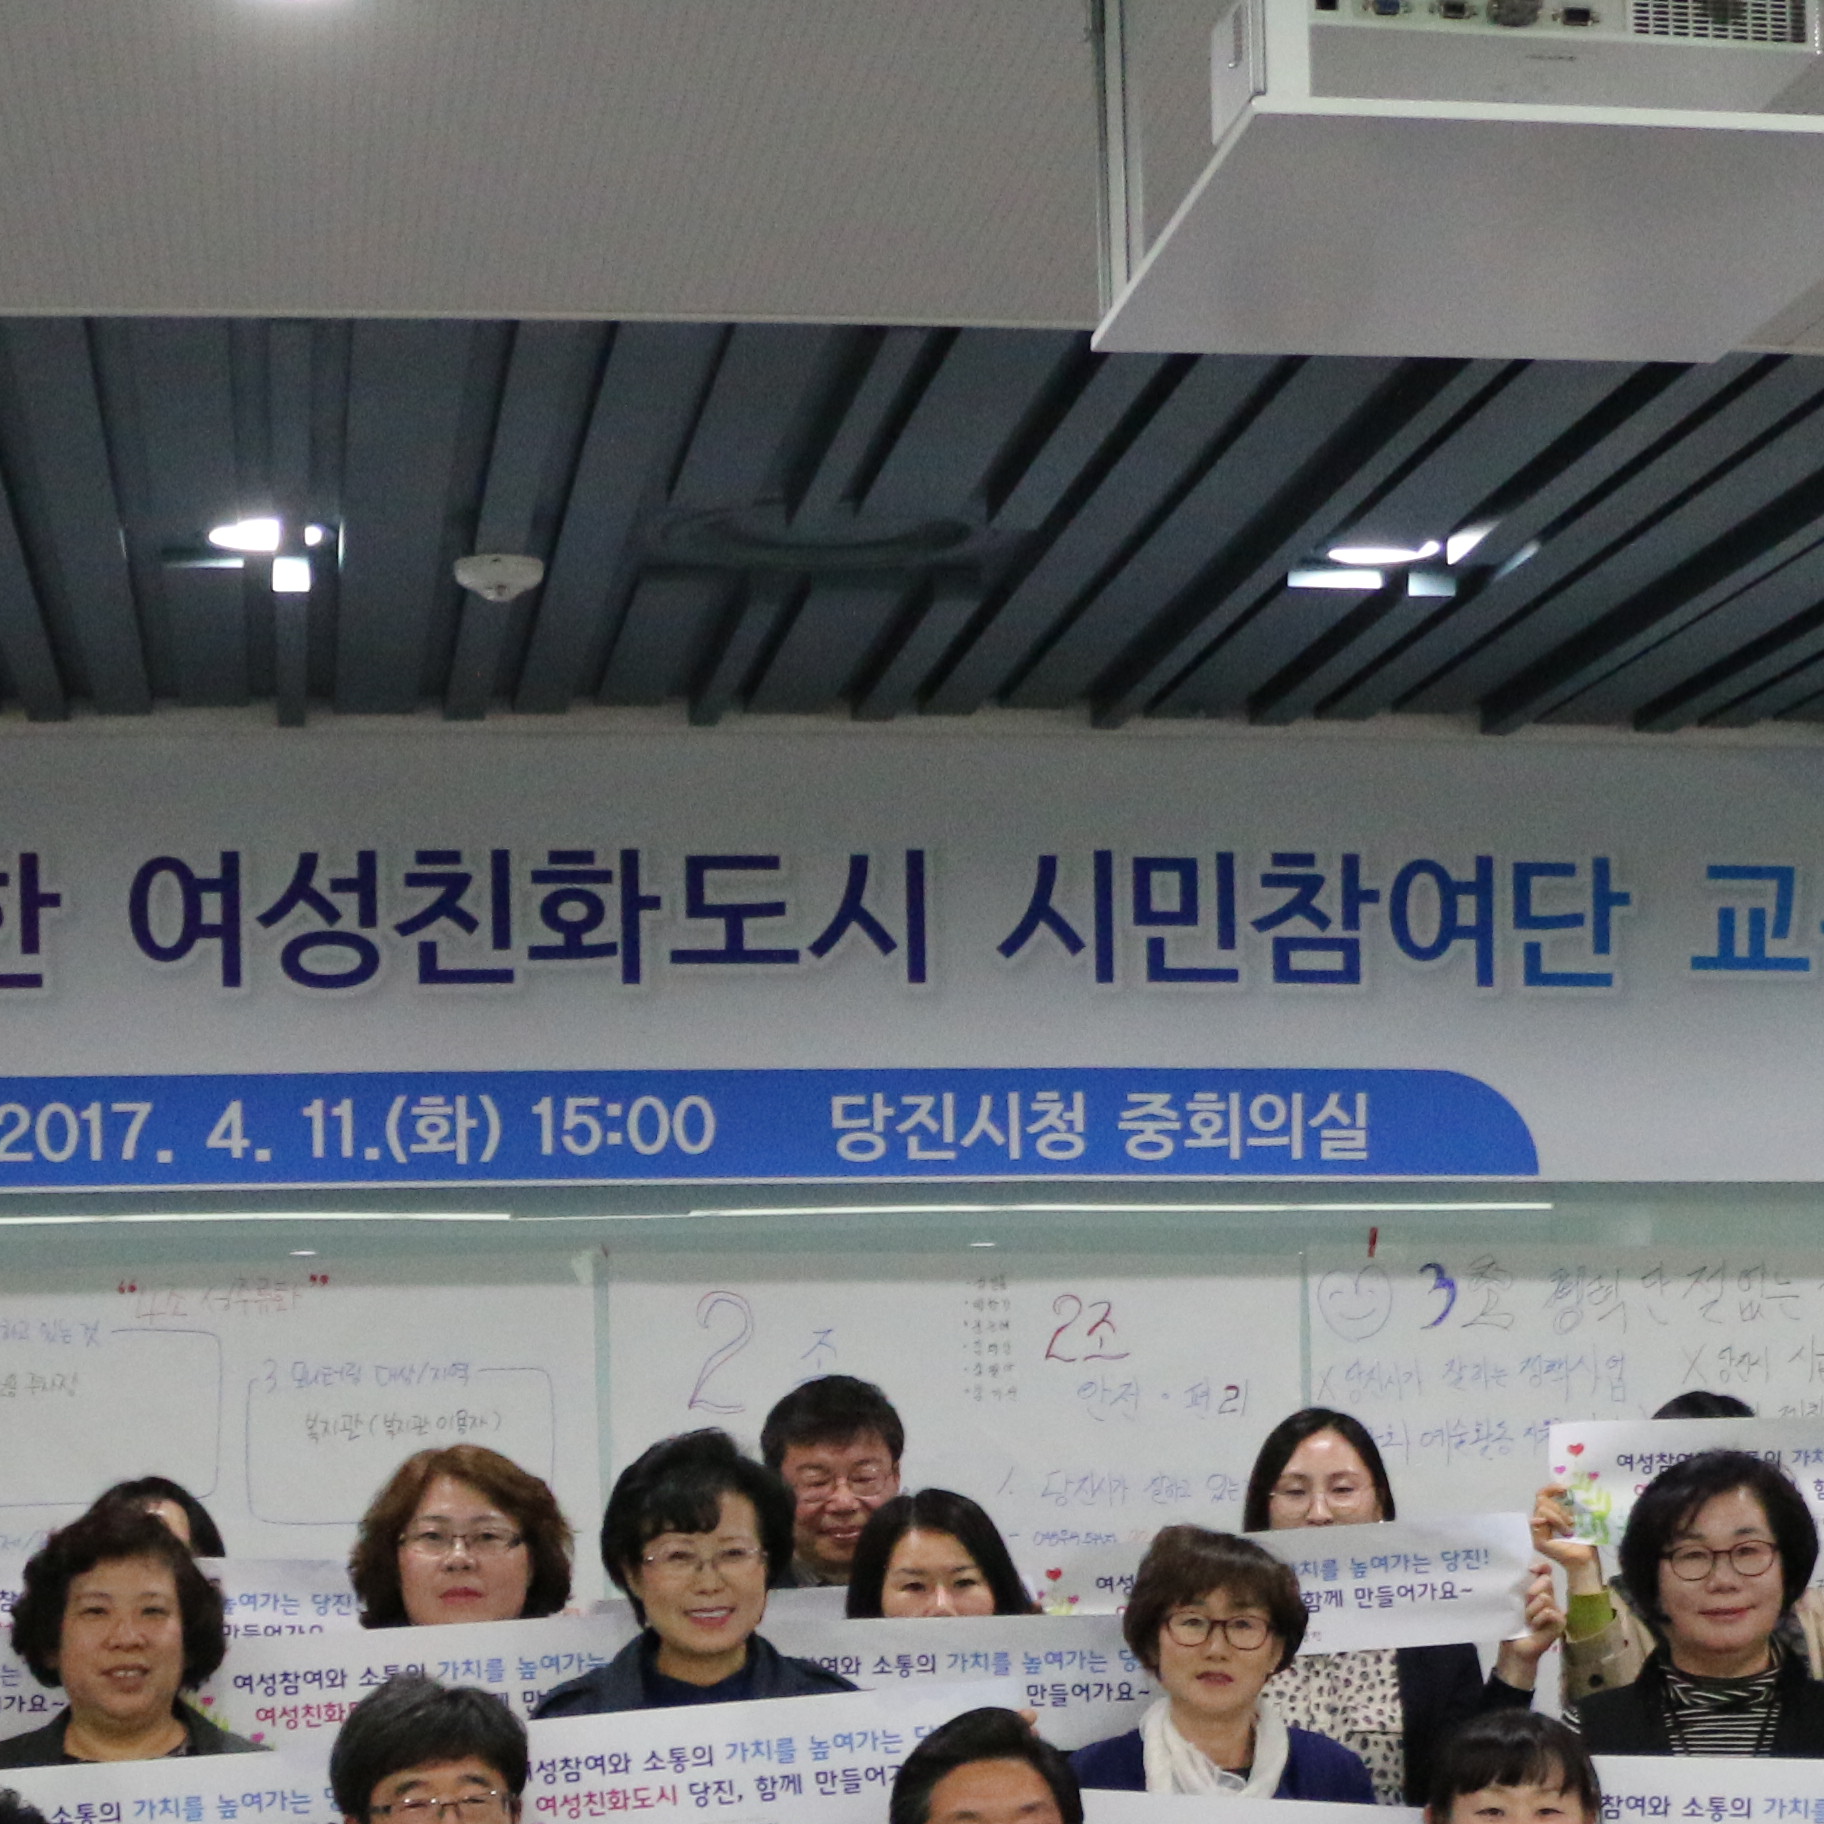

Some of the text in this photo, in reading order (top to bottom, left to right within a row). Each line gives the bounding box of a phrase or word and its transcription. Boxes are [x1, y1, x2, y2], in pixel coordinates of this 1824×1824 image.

[129, 849, 926, 989] 여성친화도시
[998, 850, 1630, 987] 시민참여단
[208, 1102, 270, 1161] 4.
[304, 1097, 500, 1163] 11.(화)
[534, 1097, 715, 1154] 15:00
[833, 1092, 1367, 1161] 당진시청 중회의실
